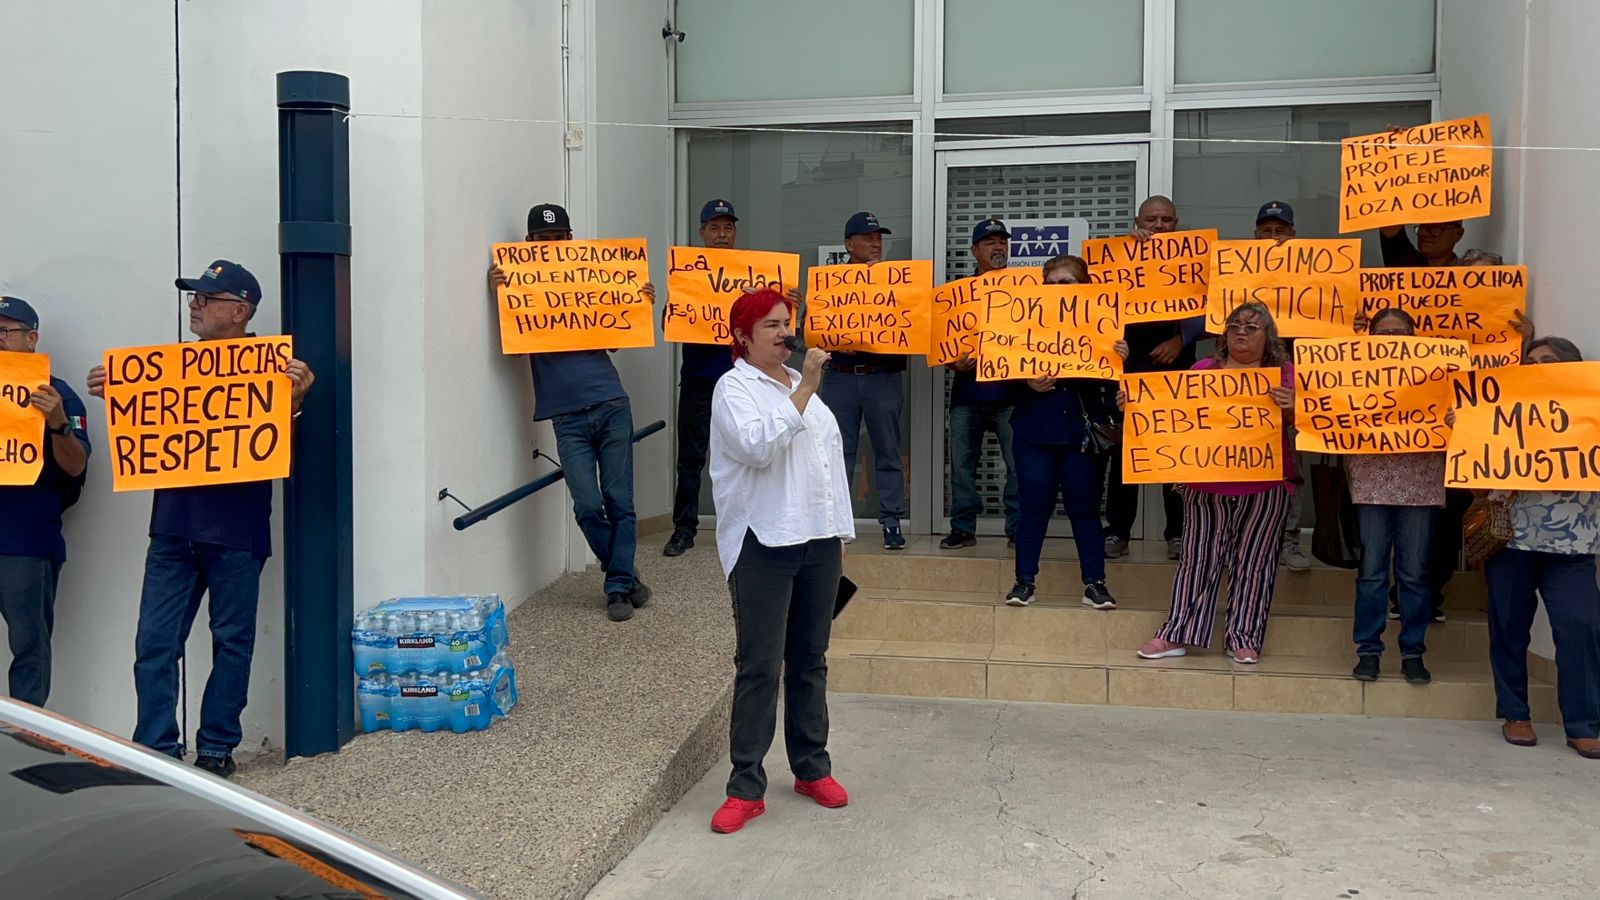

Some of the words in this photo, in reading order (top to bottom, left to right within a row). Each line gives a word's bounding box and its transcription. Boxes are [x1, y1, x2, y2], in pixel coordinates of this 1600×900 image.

[1347, 131, 1397, 160] TERE
[1406, 120, 1484, 145] GUERRA
[1345, 148, 1446, 181] PROTEJE
[1346, 183, 1367, 198] AL
[1374, 164, 1490, 192] VIOLENTADOR
[1345, 196, 1403, 220] LOZA
[1412, 185, 1482, 209] OCHOA
[497, 245, 550, 265] PROFE
[670, 249, 711, 275] La
[1087, 244, 1115, 265] LA
[1123, 236, 1208, 261] VERDAD
[1217, 245, 1354, 275] EXIGIMOS
[503, 267, 639, 288] VIOLENTADOR
[816, 269, 876, 291] FISCAL
[888, 267, 912, 285] DE
[1159, 262, 1207, 286] SER
[1360, 272, 1405, 292] PROFE
[1411, 271, 1457, 289] LOZA
[1463, 270, 1524, 288] OCHOA
[507, 294, 535, 309] DE
[545, 289, 643, 308] DERECHOS
[814, 290, 896, 310] SINALOA
[1059, 295, 1089, 327] MI
[1125, 294, 1207, 315] CUCHADA
[1363, 297, 1390, 312] NO
[1398, 293, 1464, 310] PUEDE
[515, 310, 631, 334] HUMANOS
[810, 310, 912, 331] EXIGIMOS
[946, 312, 977, 336] NO
[816, 330, 908, 349] JUSTICIA
[939, 333, 979, 363] JUS
[1021, 328, 1092, 363] todas
[1472, 330, 1508, 344] LOS
[109, 351, 163, 385] LOS
[182, 342, 291, 379] POLICIAS
[1296, 341, 1361, 365] PROFE
[1124, 378, 1155, 404] LA
[1164, 372, 1271, 400] VERDAD
[1453, 371, 1500, 409] NO
[110, 380, 273, 426] MERECEN
[1304, 395, 1332, 413] DE
[1348, 390, 1397, 411] LOS
[1132, 406, 1211, 437] DEBE
[1226, 405, 1275, 430] SER
[1311, 404, 1437, 430] DERECHOS
[1493, 400, 1569, 449] MAS
[116, 423, 278, 476] RESPETO
[1322, 425, 1447, 451] HUMANOS
[1130, 442, 1274, 473] ESCUCHADA
[1448, 443, 1600, 484] INJUSTIC
